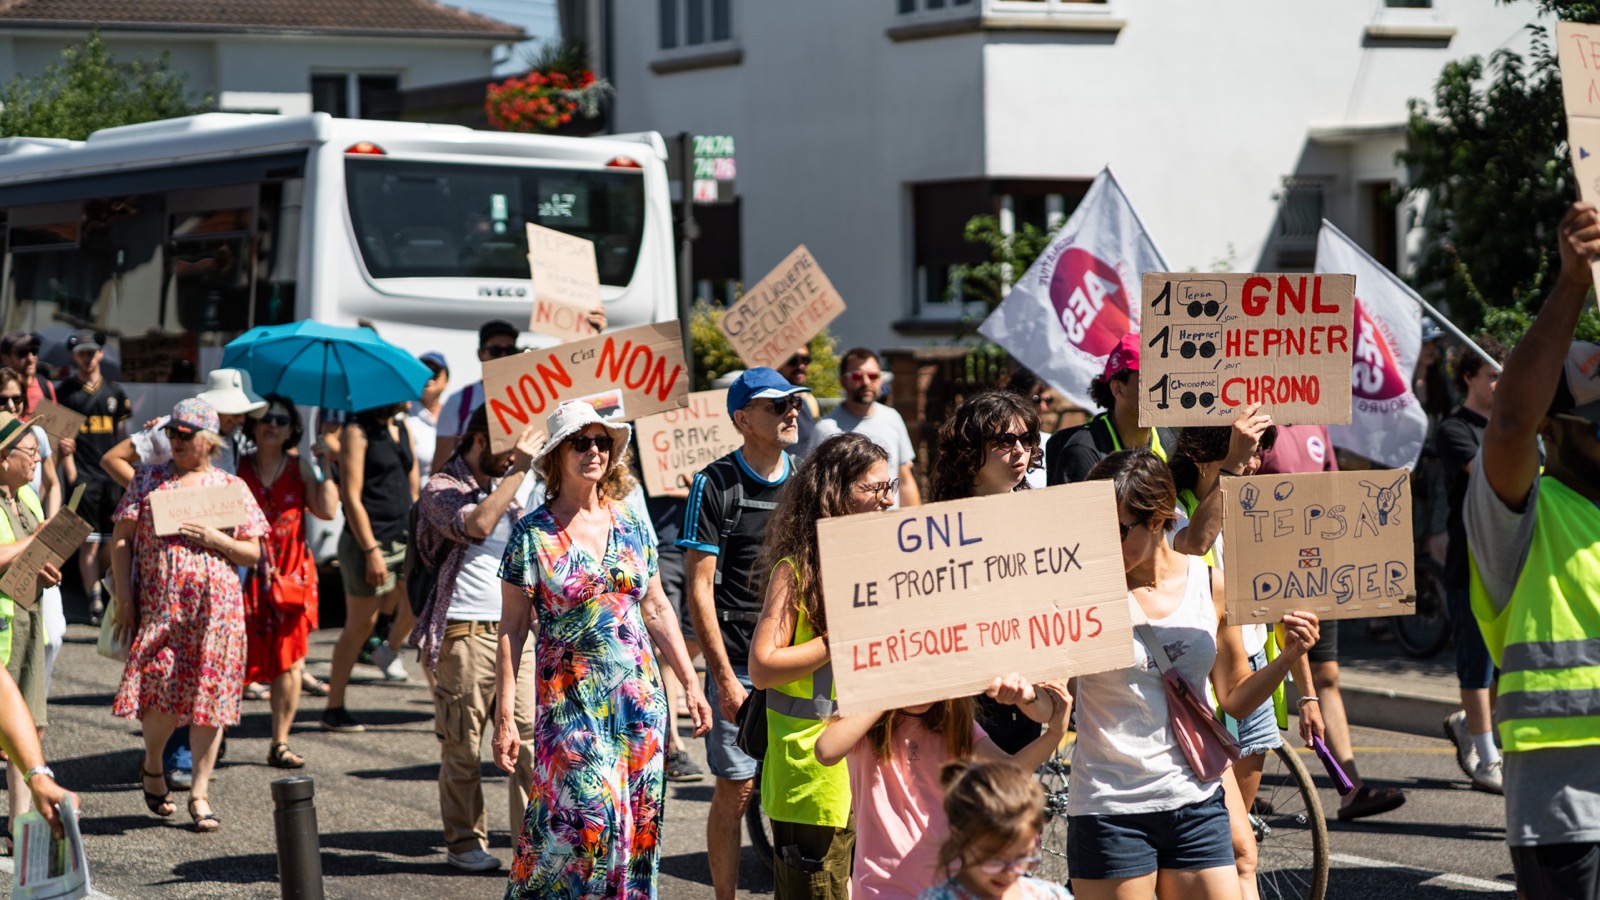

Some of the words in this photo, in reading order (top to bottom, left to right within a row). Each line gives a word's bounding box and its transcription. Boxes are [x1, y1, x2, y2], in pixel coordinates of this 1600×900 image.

[478, 286, 526, 297] IVECO
[1184, 286, 1213, 301] Tepsa
[1241, 275, 1340, 317] GNL
[722, 294, 765, 336] GAZ
[1179, 329, 1220, 341] Heppner
[489, 353, 573, 435] NON
[595, 336, 681, 402] NON
[1170, 380, 1216, 391] Chronopost
[1221, 374, 1320, 407] CHRONO
[652, 425, 721, 452] GRAVE
[898, 512, 983, 552] GNL
[1243, 502, 1379, 542] TEPSA
[853, 581, 878, 608] LE
[984, 552, 1028, 582] POUR
[1034, 543, 1082, 575] EUX
[1253, 560, 1408, 605] DANGER
[853, 641, 882, 672] LE
[976, 618, 1021, 647] POUR
[1029, 606, 1103, 650] NOUS
